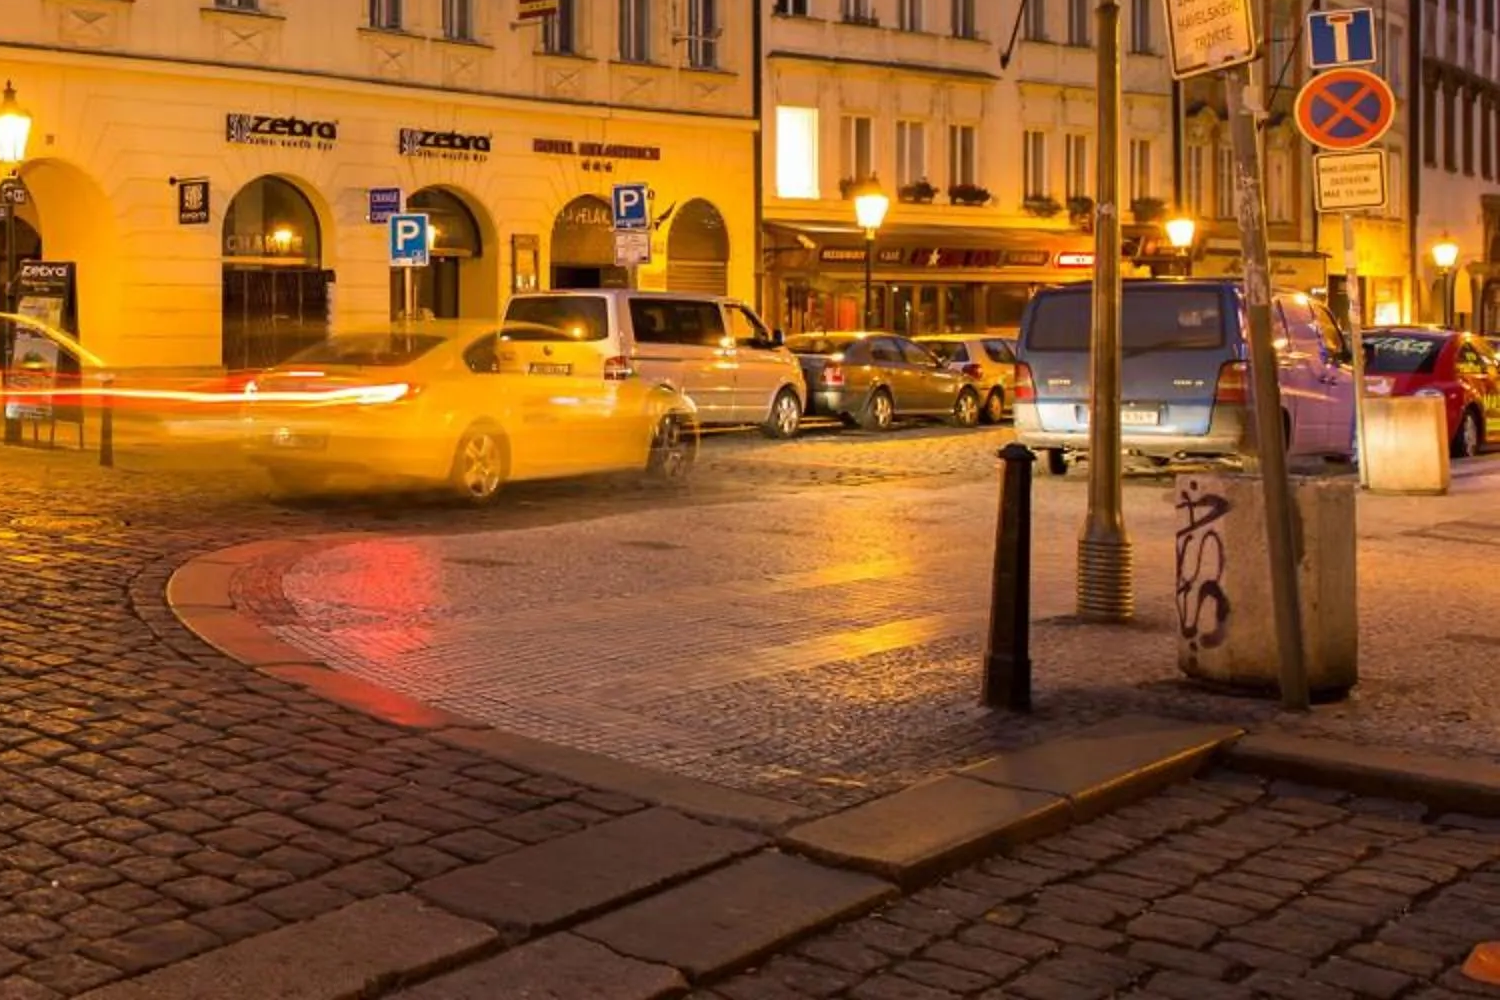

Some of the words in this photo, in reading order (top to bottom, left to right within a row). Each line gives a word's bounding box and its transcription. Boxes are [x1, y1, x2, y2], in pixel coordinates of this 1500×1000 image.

[251, 115, 337, 140] zebra
[420, 130, 490, 152] zebra
[619, 189, 639, 217] P
[396, 220, 420, 250] P
